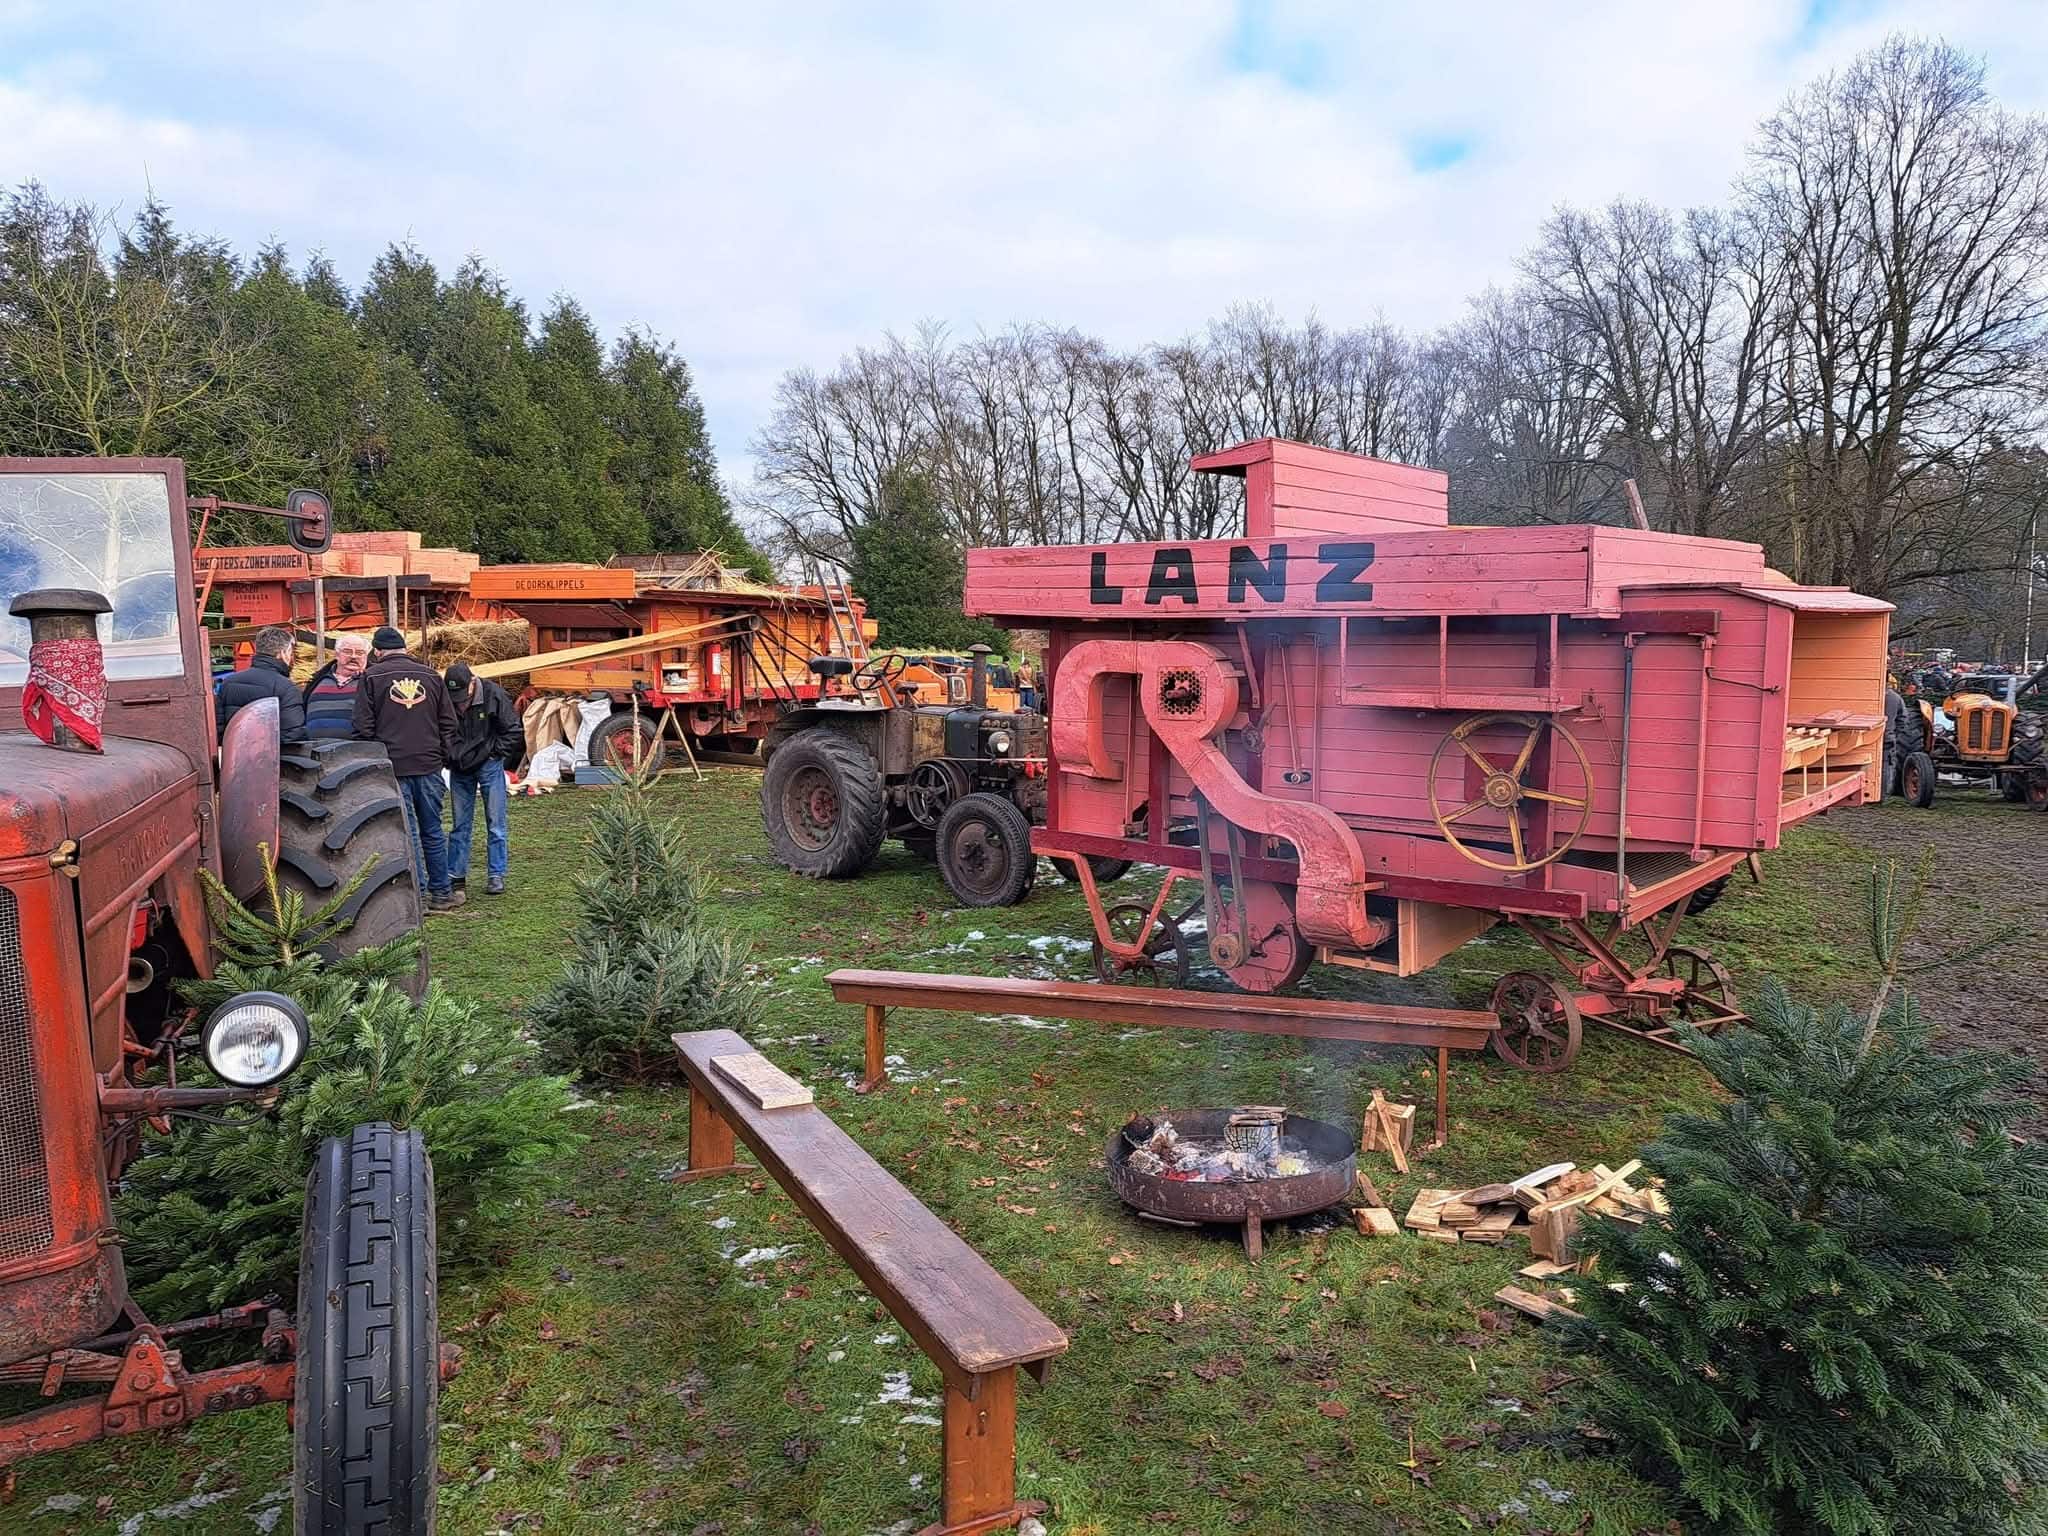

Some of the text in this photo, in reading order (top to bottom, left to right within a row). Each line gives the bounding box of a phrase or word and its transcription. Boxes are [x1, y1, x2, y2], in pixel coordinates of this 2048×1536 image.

[244, 555, 270, 569] ZONEN
[271, 554, 302, 568] HAAREN
[1090, 542, 1375, 604] LANZ
